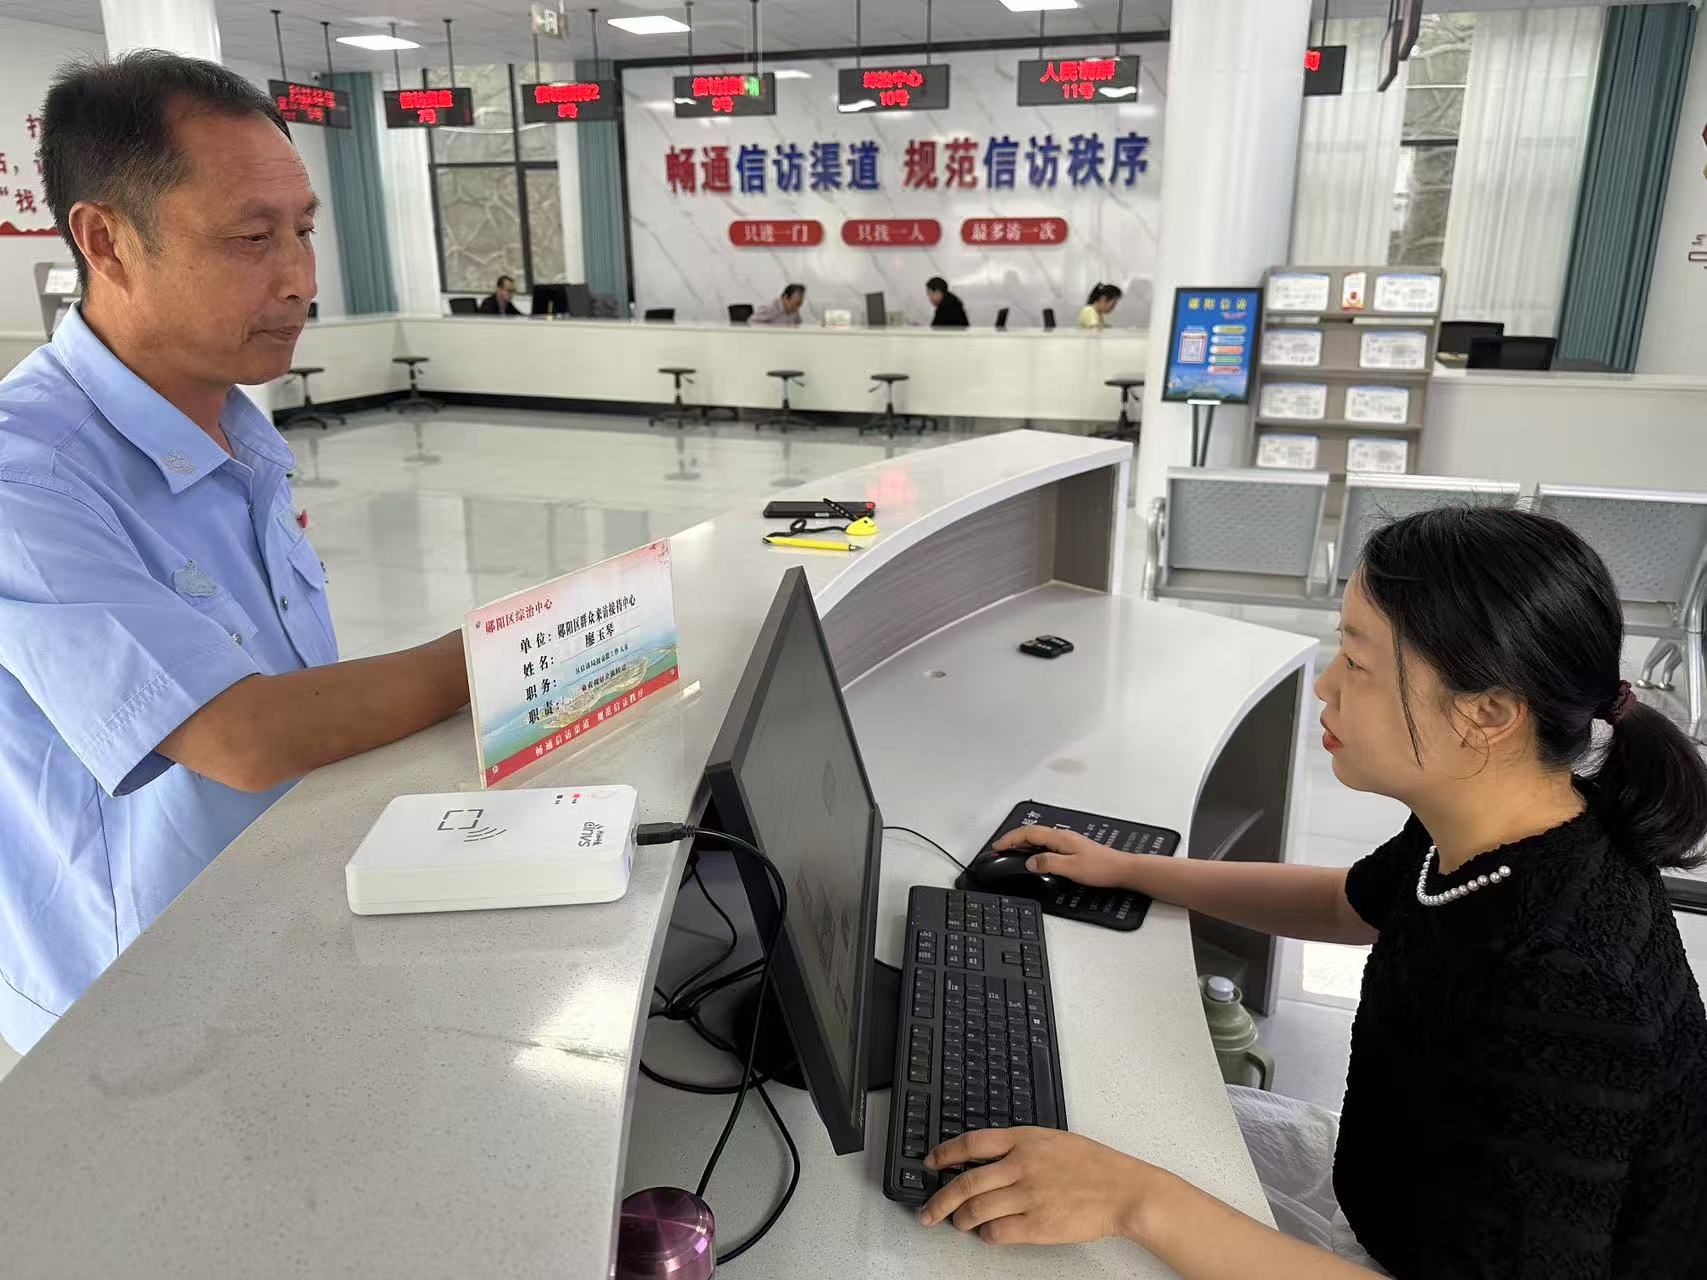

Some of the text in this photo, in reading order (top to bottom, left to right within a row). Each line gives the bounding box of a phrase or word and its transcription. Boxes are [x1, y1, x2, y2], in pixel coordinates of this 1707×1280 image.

[879, 89, 910, 107] 10号
[1062, 82, 1096, 101] 11号
[664, 131, 1151, 195] 畅通信访渠道 规范信访秩序
[485, 598, 553, 635] 郧阳区综治中心
[523, 623, 615, 678] 姓名： 廖玉琴
[525, 678, 558, 702] 职务：
[528, 700, 561, 726] 职责：
[535, 719, 591, 758] 畅通信访渠道
